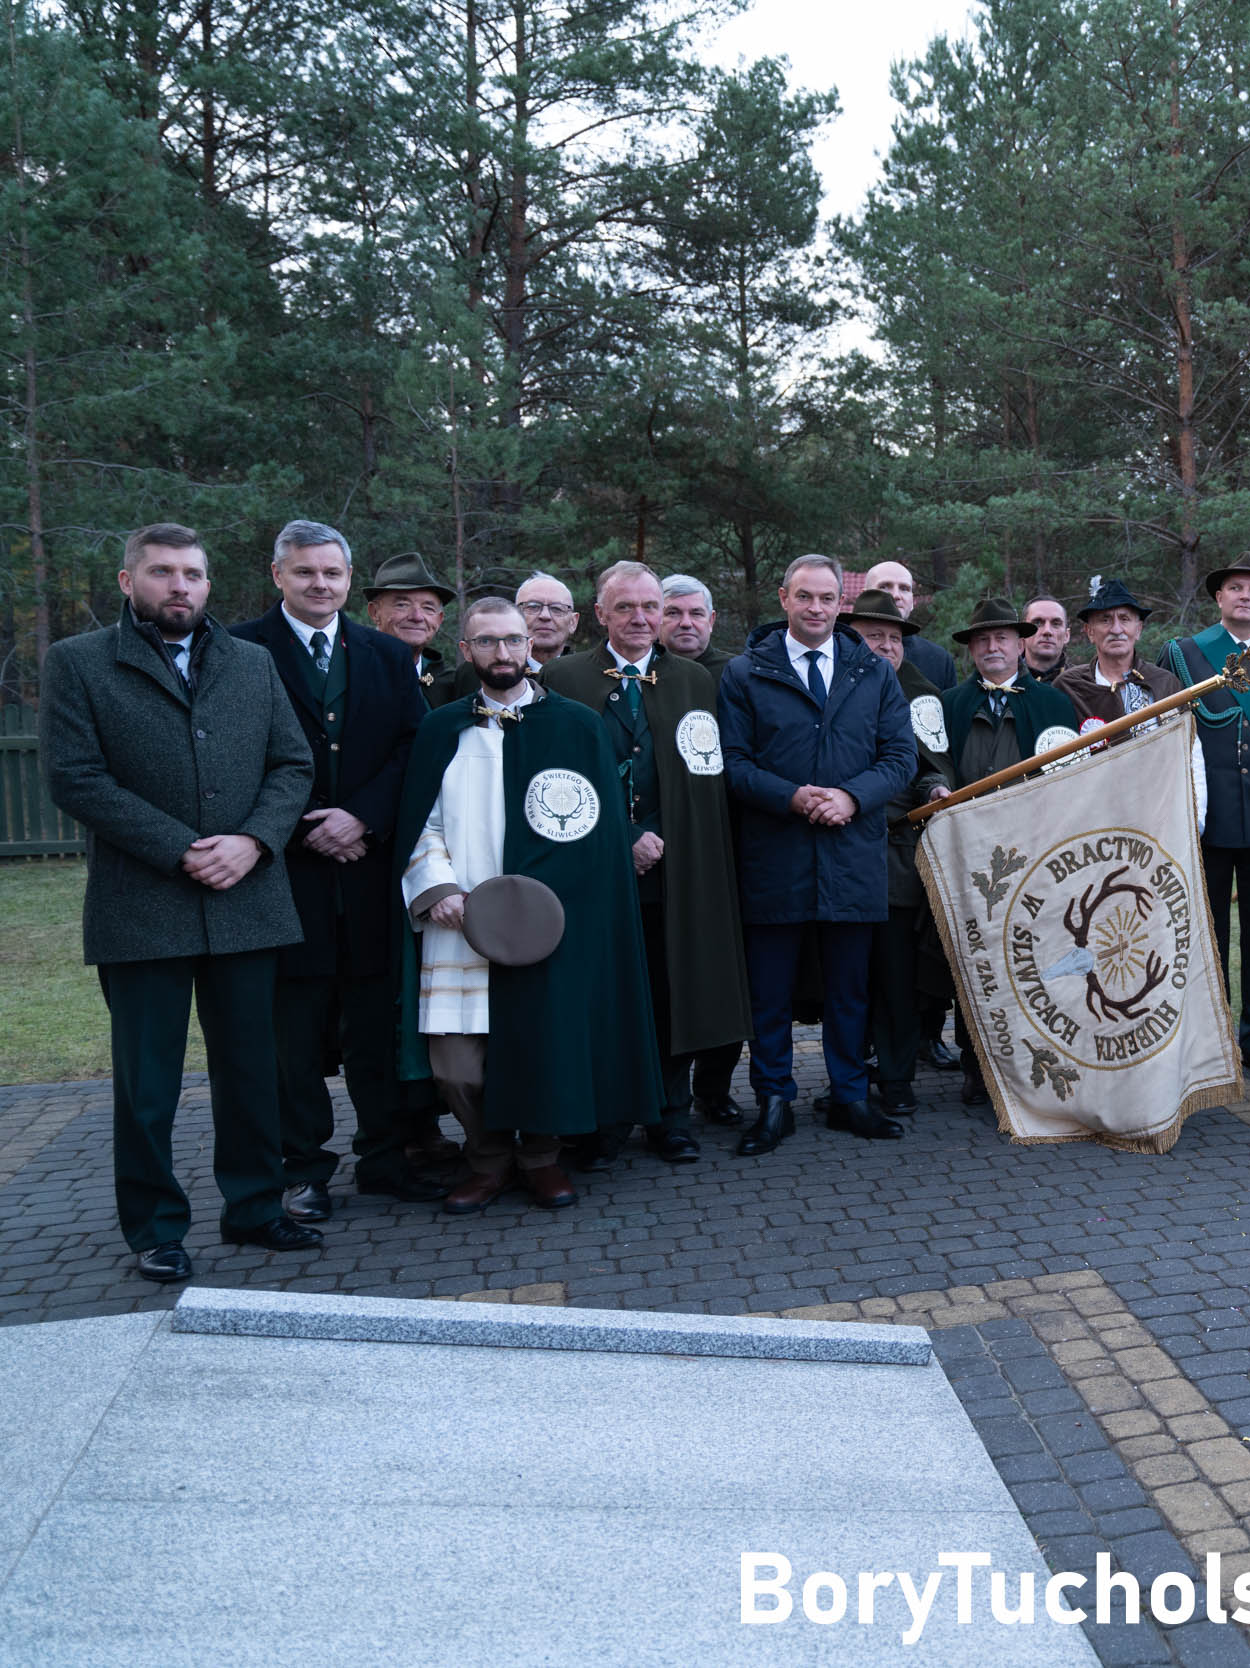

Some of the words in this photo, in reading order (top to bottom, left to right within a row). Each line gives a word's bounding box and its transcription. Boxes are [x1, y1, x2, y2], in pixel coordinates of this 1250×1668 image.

[1045, 836, 1154, 884] BRACTWO
[1020, 893, 1046, 921] W
[1150, 861, 1191, 990] ŚWIĘTEGO
[965, 917, 988, 955] ROK
[989, 1007, 1015, 1057] 2000
[1012, 925, 1081, 1047] ŚLIWICACH
[1093, 999, 1180, 1062] HUBERTA
